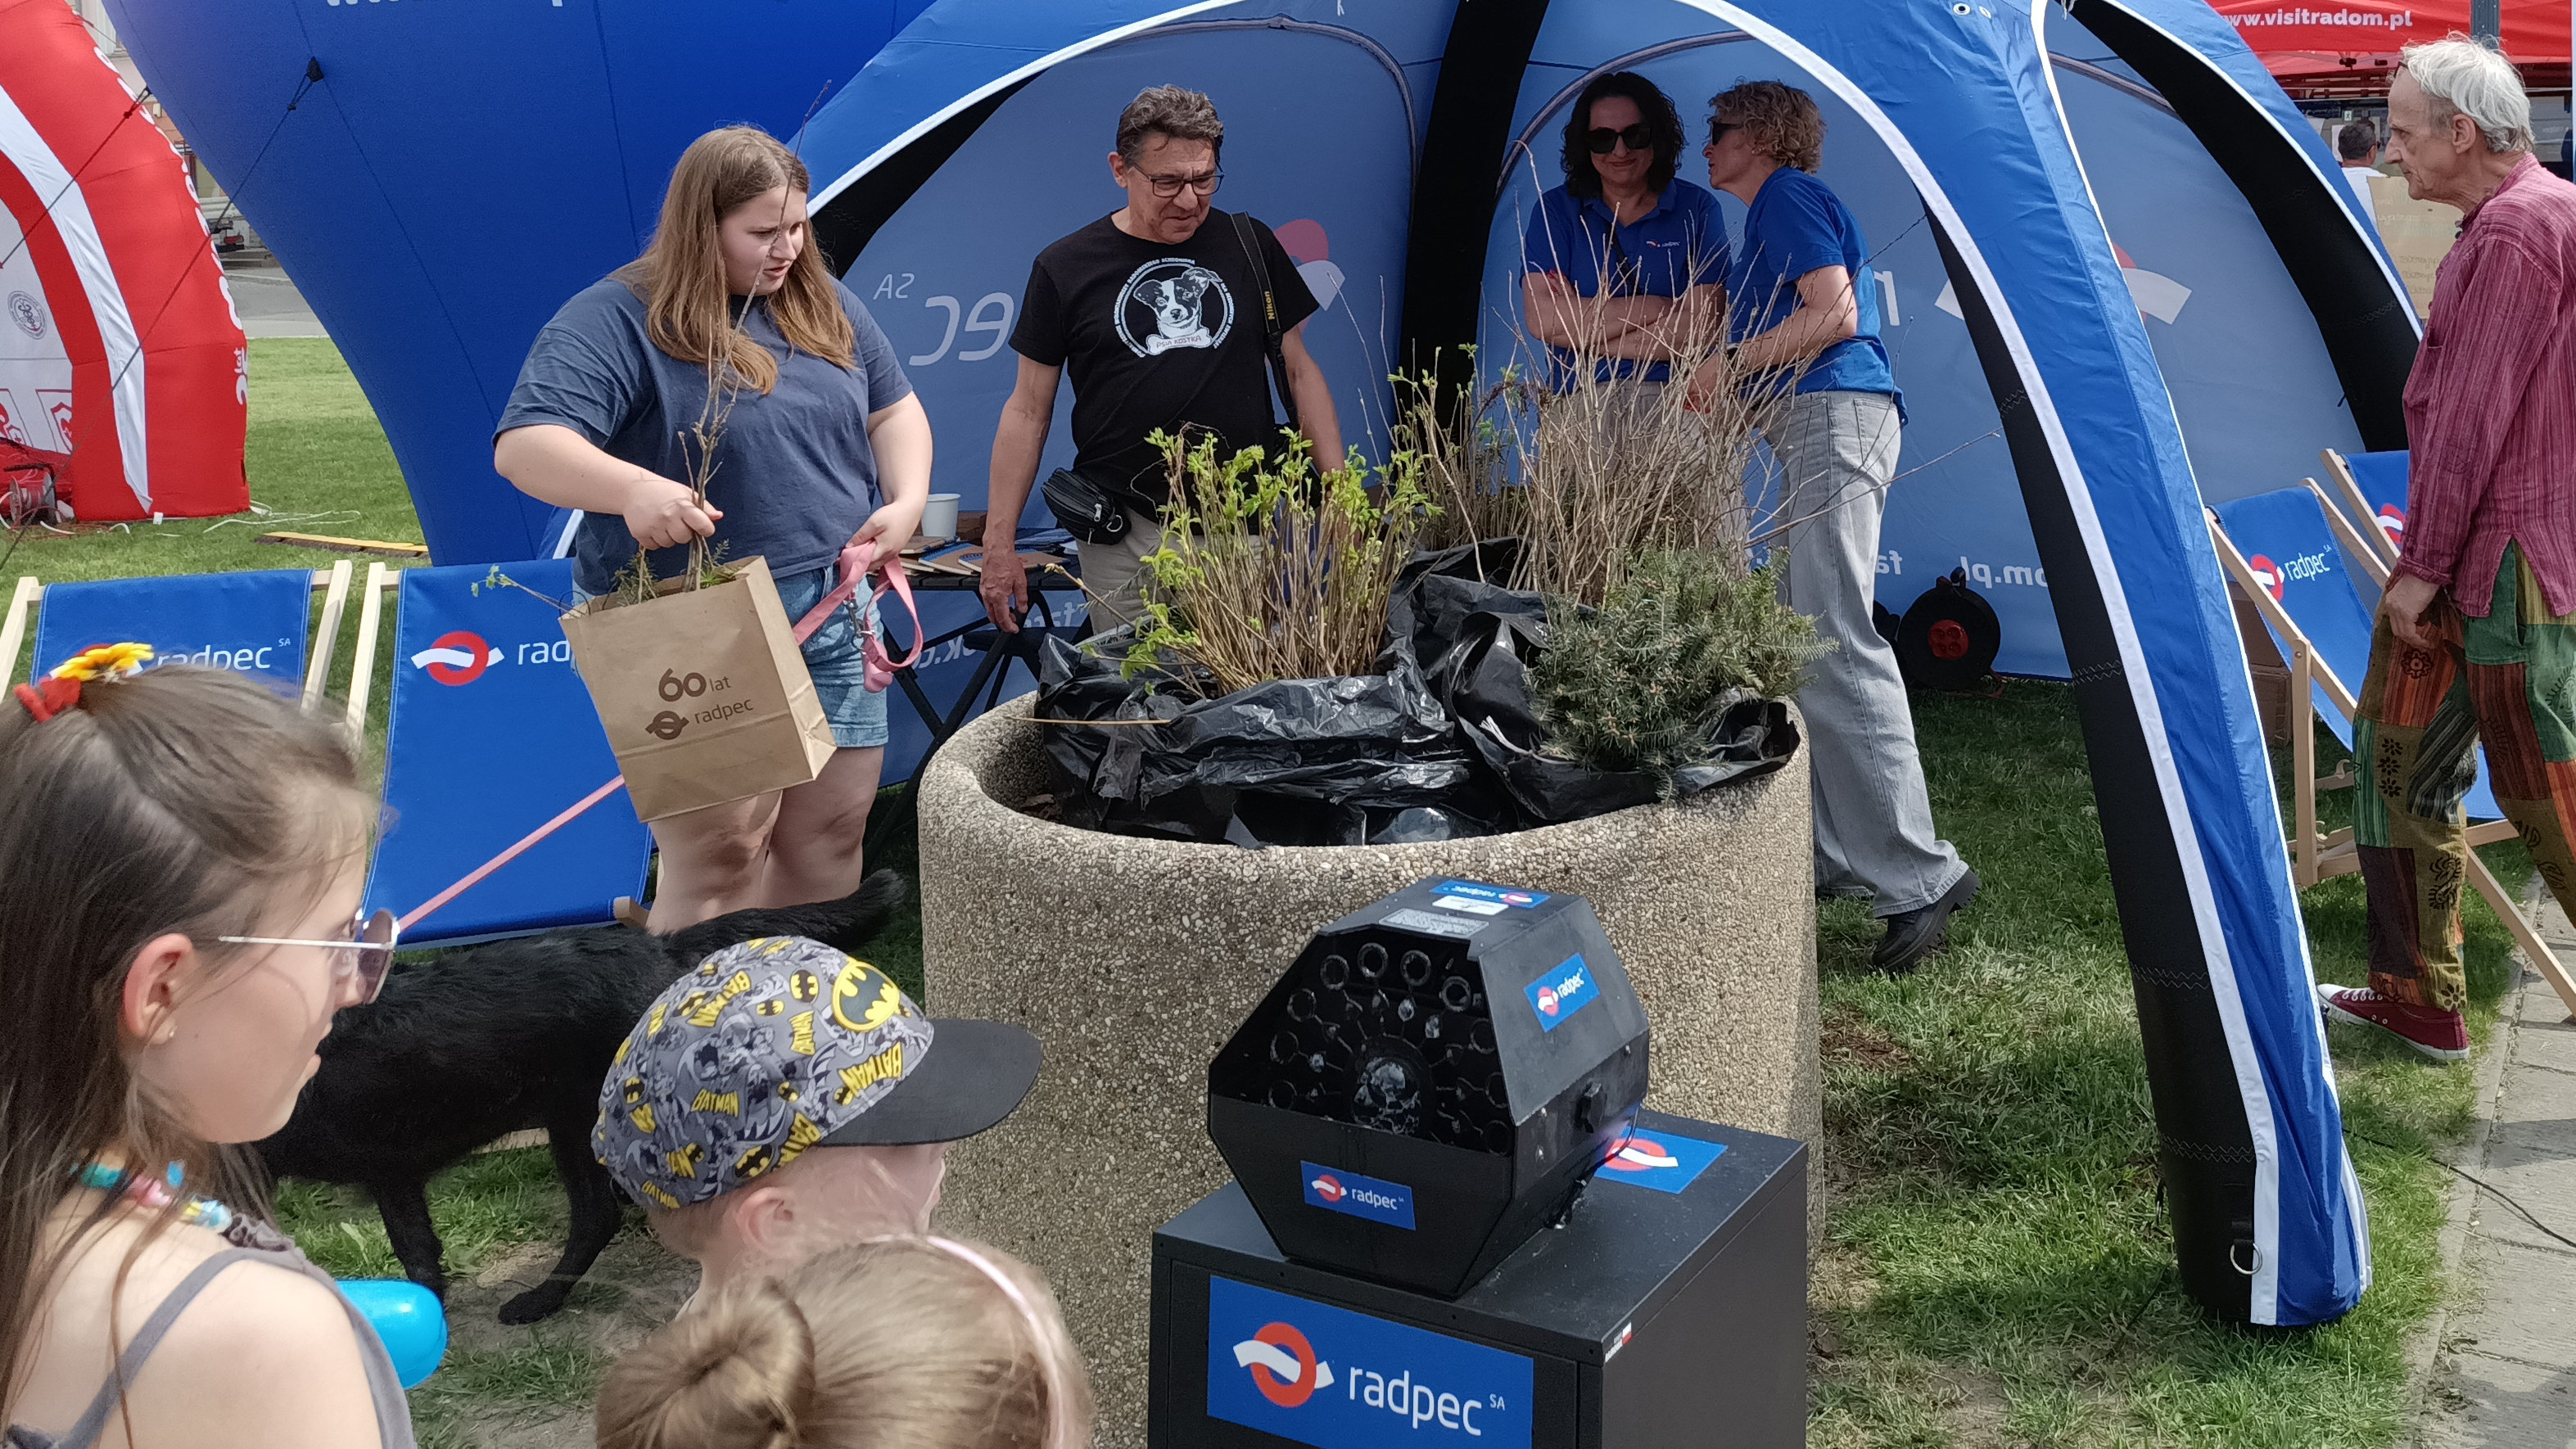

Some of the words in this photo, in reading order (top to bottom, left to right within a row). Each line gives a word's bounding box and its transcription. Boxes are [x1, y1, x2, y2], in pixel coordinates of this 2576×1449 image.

[1264, 291, 1276, 320] Nikon
[2285, 553, 2330, 581] radpec
[278, 638, 291, 647] SA
[518, 640, 571, 665] rad
[658, 668, 707, 702] 60
[709, 675, 731, 692] lat
[694, 699, 754, 724] radpec
[838, 1041, 903, 1098] BATMAN
[691, 1089, 739, 1117] BATMAN
[1352, 1189, 1397, 1210] radpec
[1349, 1366, 1482, 1436] radpec
[1489, 1393, 1505, 1411] SA
